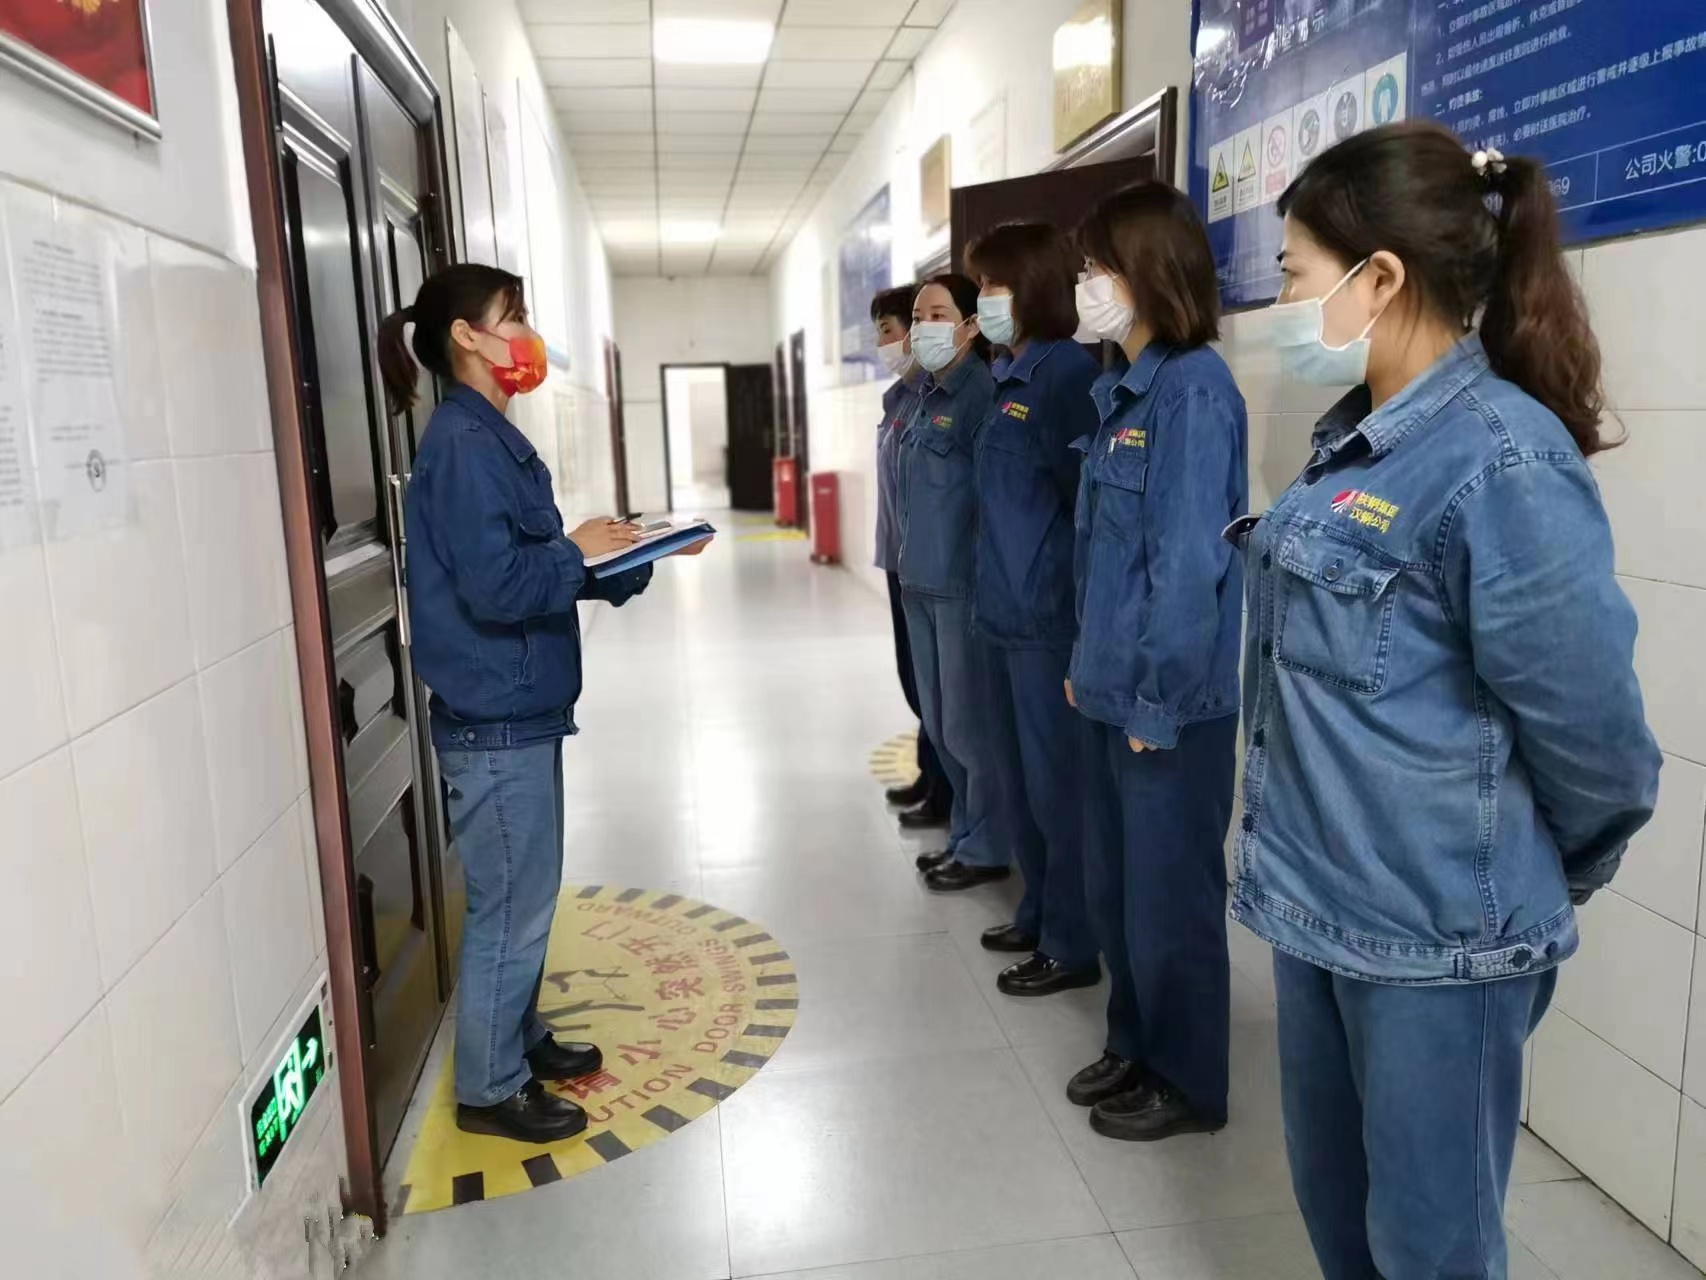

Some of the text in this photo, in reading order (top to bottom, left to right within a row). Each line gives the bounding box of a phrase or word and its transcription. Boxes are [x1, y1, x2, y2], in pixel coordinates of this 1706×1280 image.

[698, 938, 746, 994] SWINGS
[694, 1002, 744, 1054] DOOR
[588, 1063, 694, 1123] UTION
